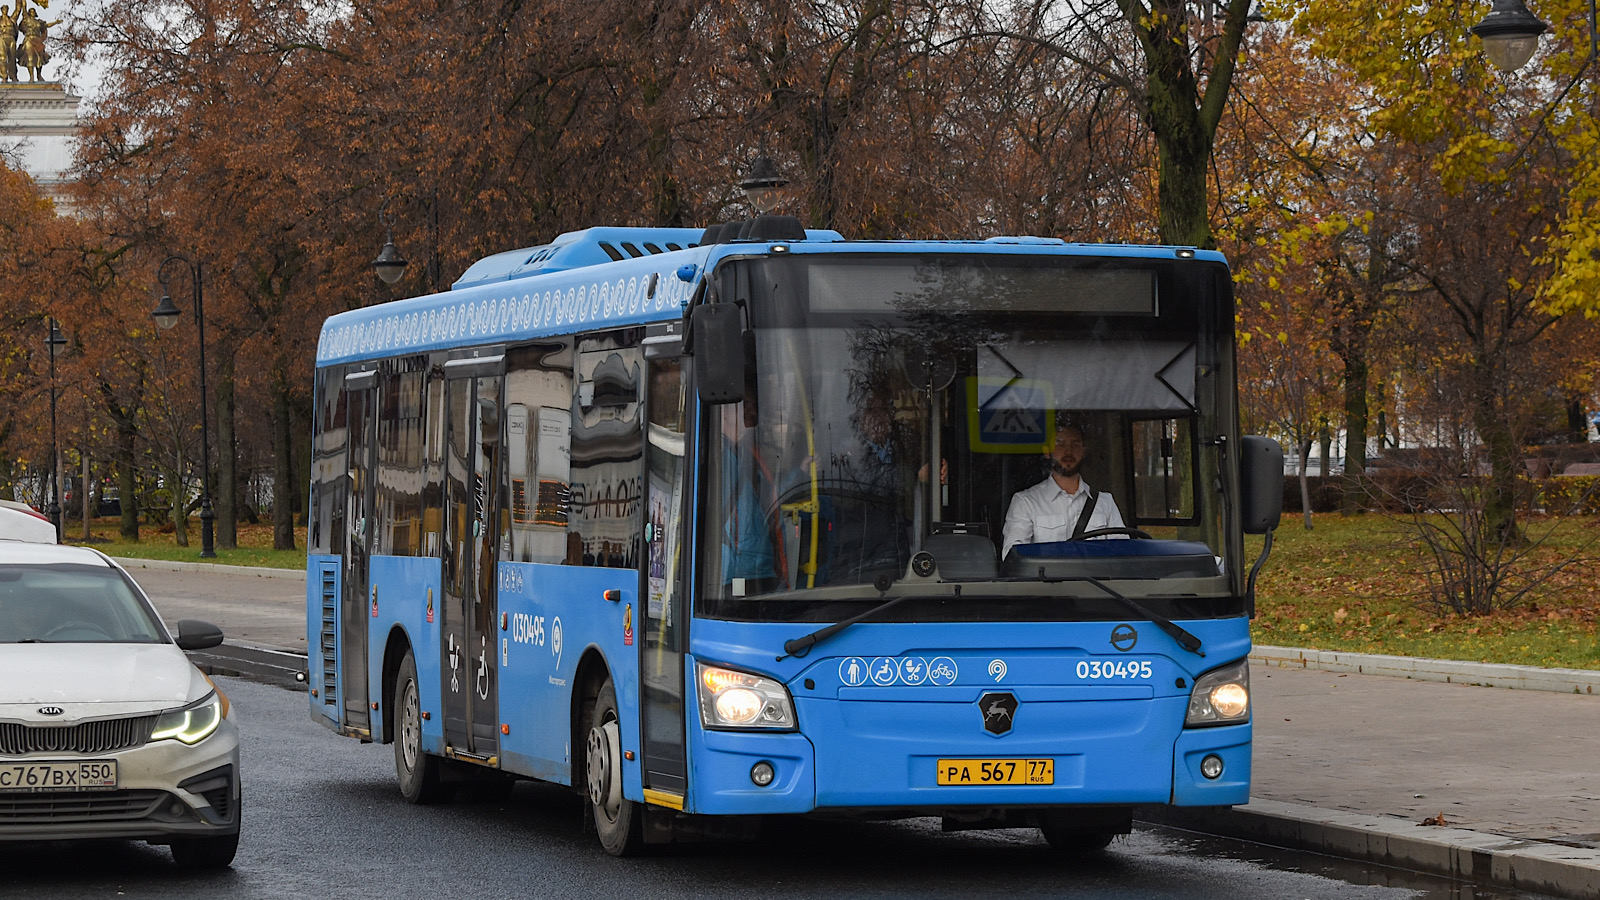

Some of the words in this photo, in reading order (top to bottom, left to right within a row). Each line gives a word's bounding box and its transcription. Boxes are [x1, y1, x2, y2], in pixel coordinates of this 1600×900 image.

[513, 613, 545, 647] 030495
[1076, 661, 1153, 679] 030495
[81, 764, 110, 779] 550
[948, 767, 971, 782] РА
[981, 763, 1016, 782] 567
[1029, 762, 1047, 776] 77
